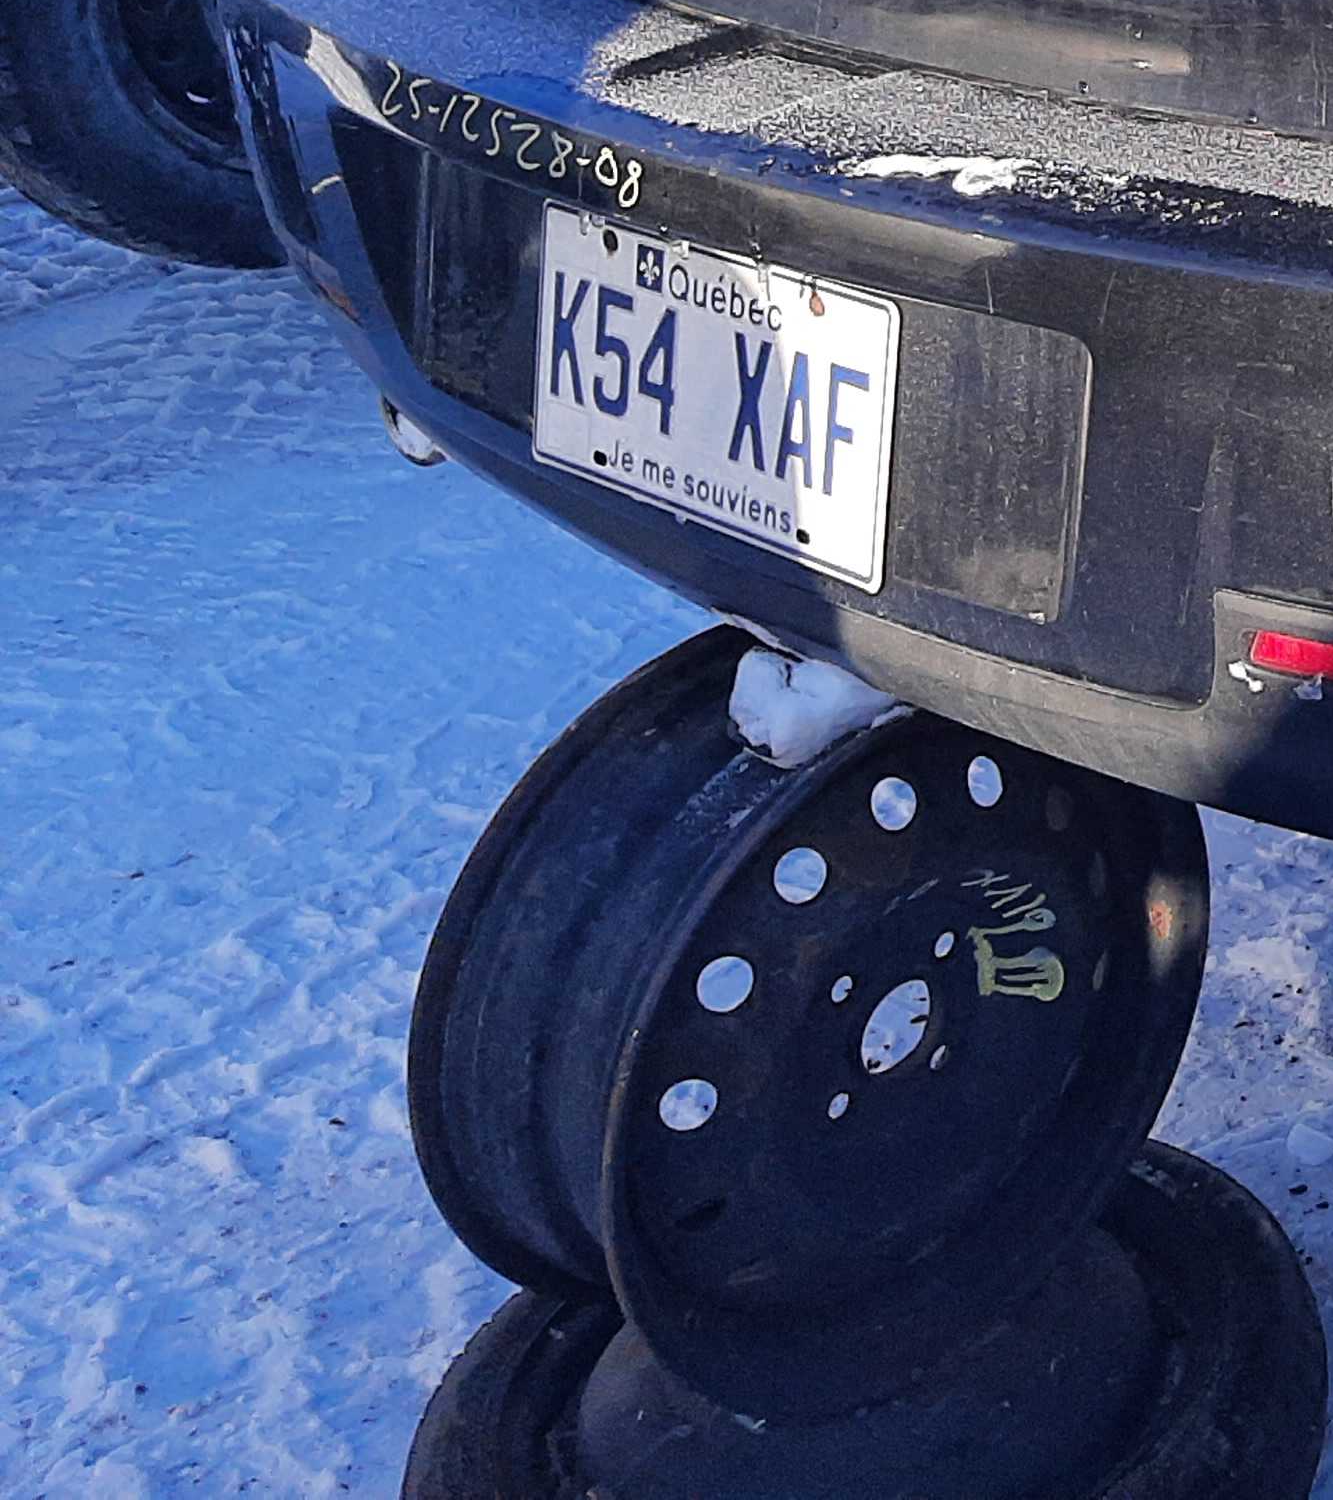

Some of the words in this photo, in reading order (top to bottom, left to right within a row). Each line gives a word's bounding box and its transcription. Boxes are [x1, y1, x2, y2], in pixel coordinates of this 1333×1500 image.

[381, 59, 642, 208] 25-12528-08
[667, 263, 783, 332] Québec
[550, 270, 679, 436] K54
[727, 331, 870, 496] XAF
[607, 439, 635, 474] Je
[642, 459, 684, 489] me
[683, 473, 793, 534] souviens
